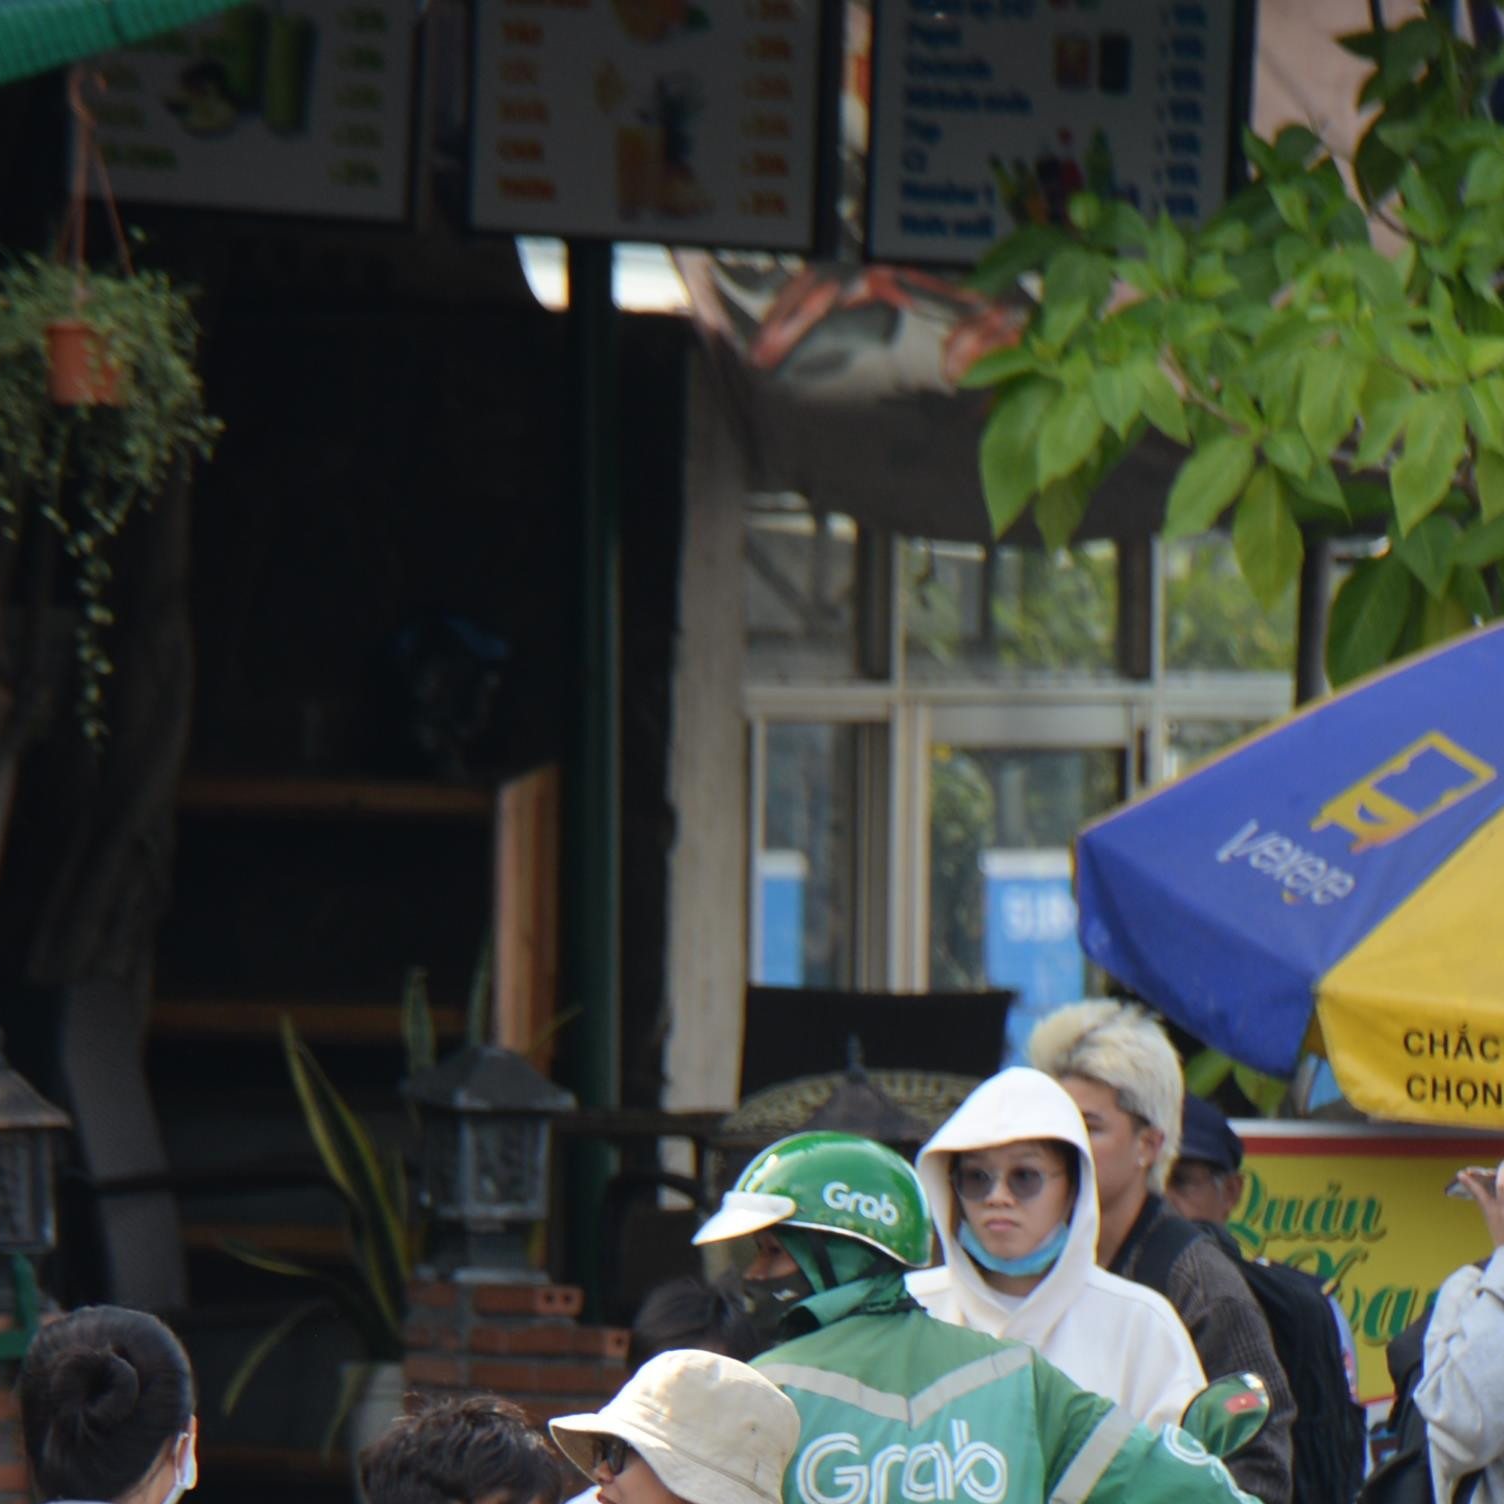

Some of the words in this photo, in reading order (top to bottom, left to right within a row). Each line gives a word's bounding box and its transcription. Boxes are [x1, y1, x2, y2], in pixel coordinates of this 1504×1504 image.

[1215, 819, 1357, 905] Vexere
[1403, 1022, 1500, 1062] CHẮC
[1405, 1074, 1503, 1112] CHỌN
[822, 1180, 900, 1227] Grab
